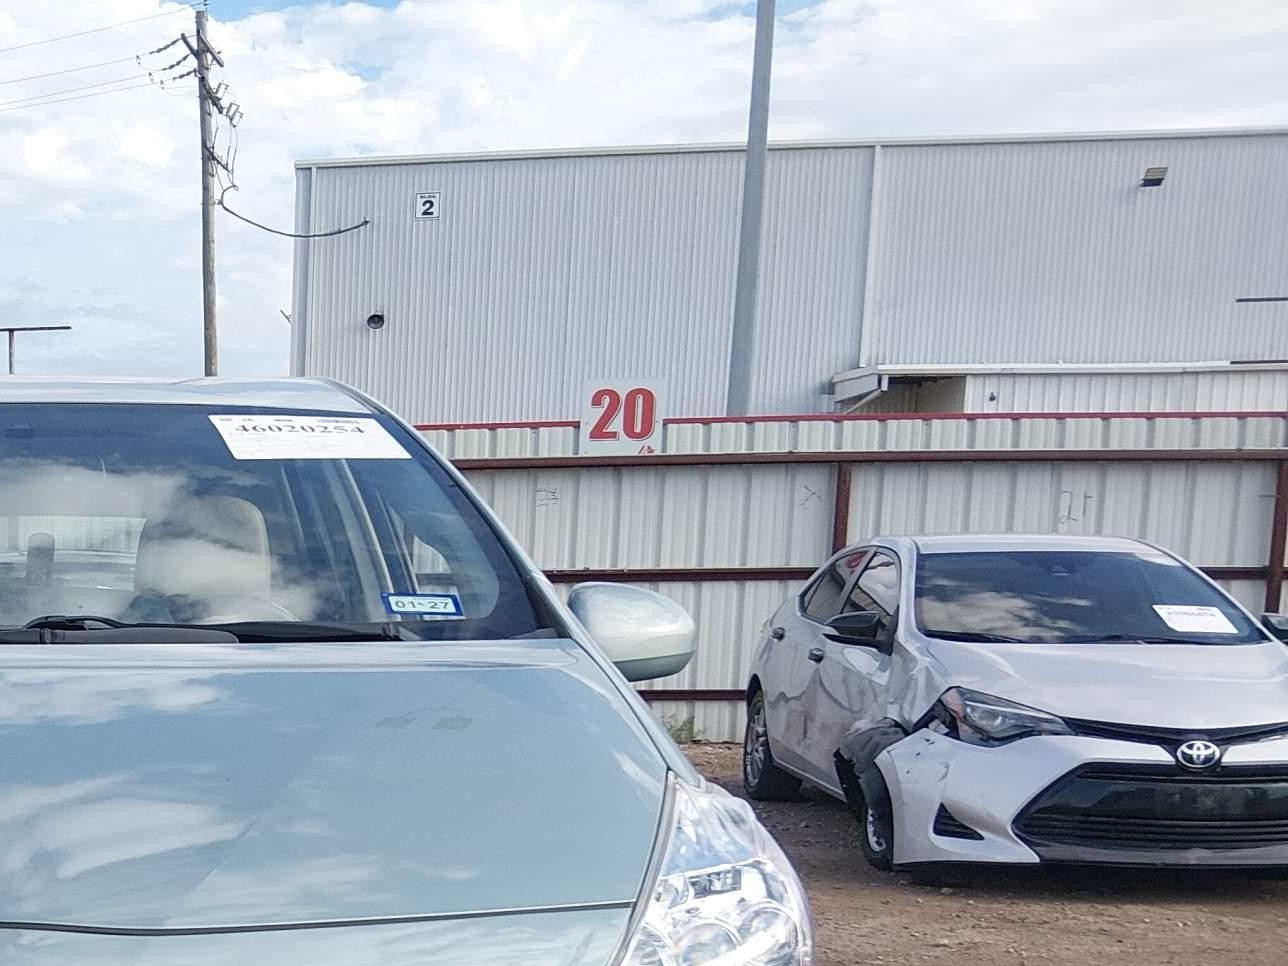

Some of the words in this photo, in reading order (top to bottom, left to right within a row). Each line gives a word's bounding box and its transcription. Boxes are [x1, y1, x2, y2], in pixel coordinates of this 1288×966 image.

[420, 200, 435, 216] 2
[588, 387, 656, 441] 20
[234, 424, 365, 434] 46020254
